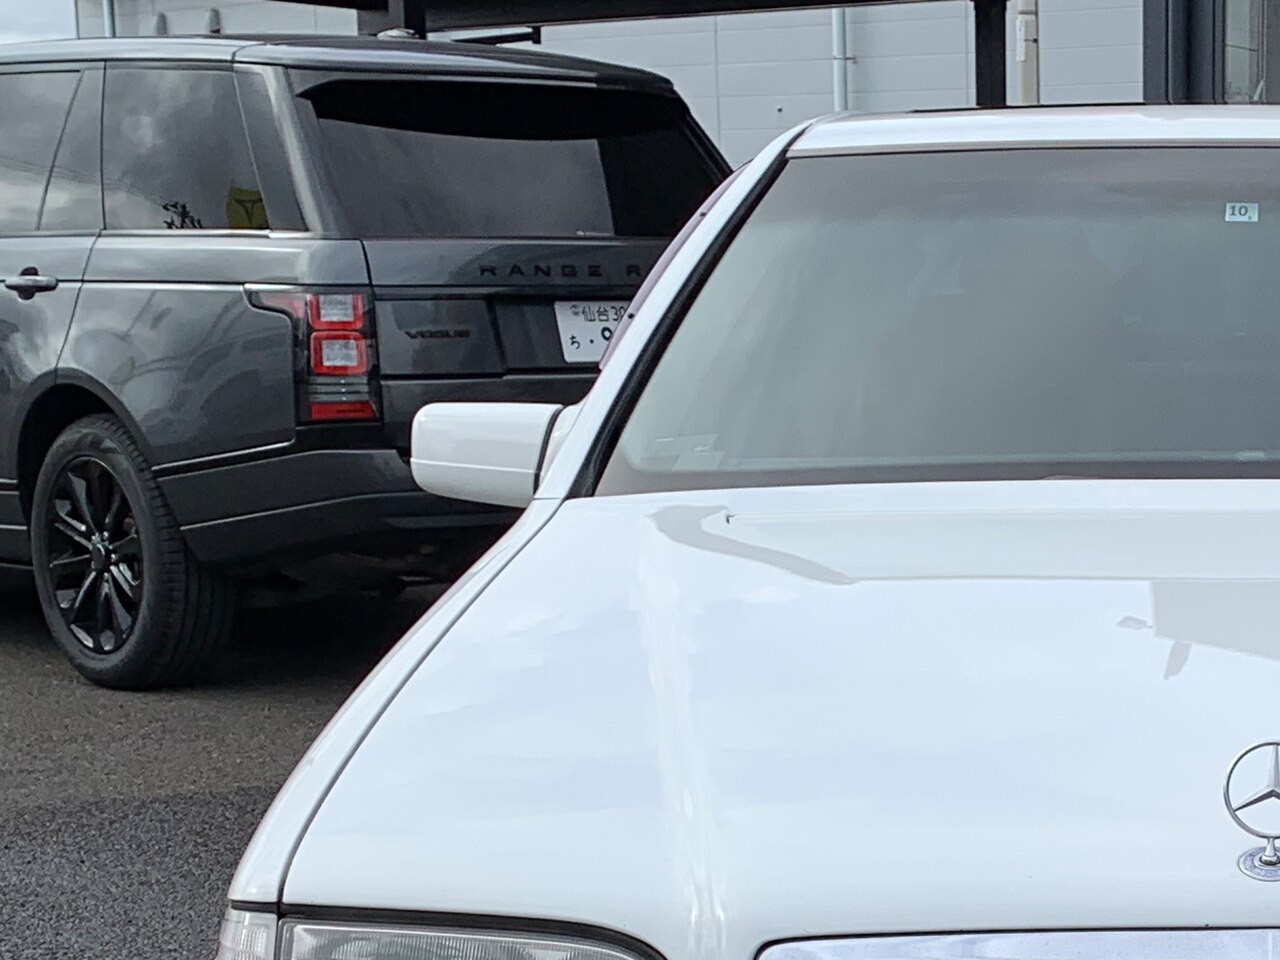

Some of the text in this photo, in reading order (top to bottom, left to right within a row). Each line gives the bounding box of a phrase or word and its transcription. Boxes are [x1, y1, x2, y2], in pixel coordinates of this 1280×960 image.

[1230, 204, 1248, 217] 10
[479, 263, 642, 278] RANGE R
[404, 329, 470, 339] VOGUE
